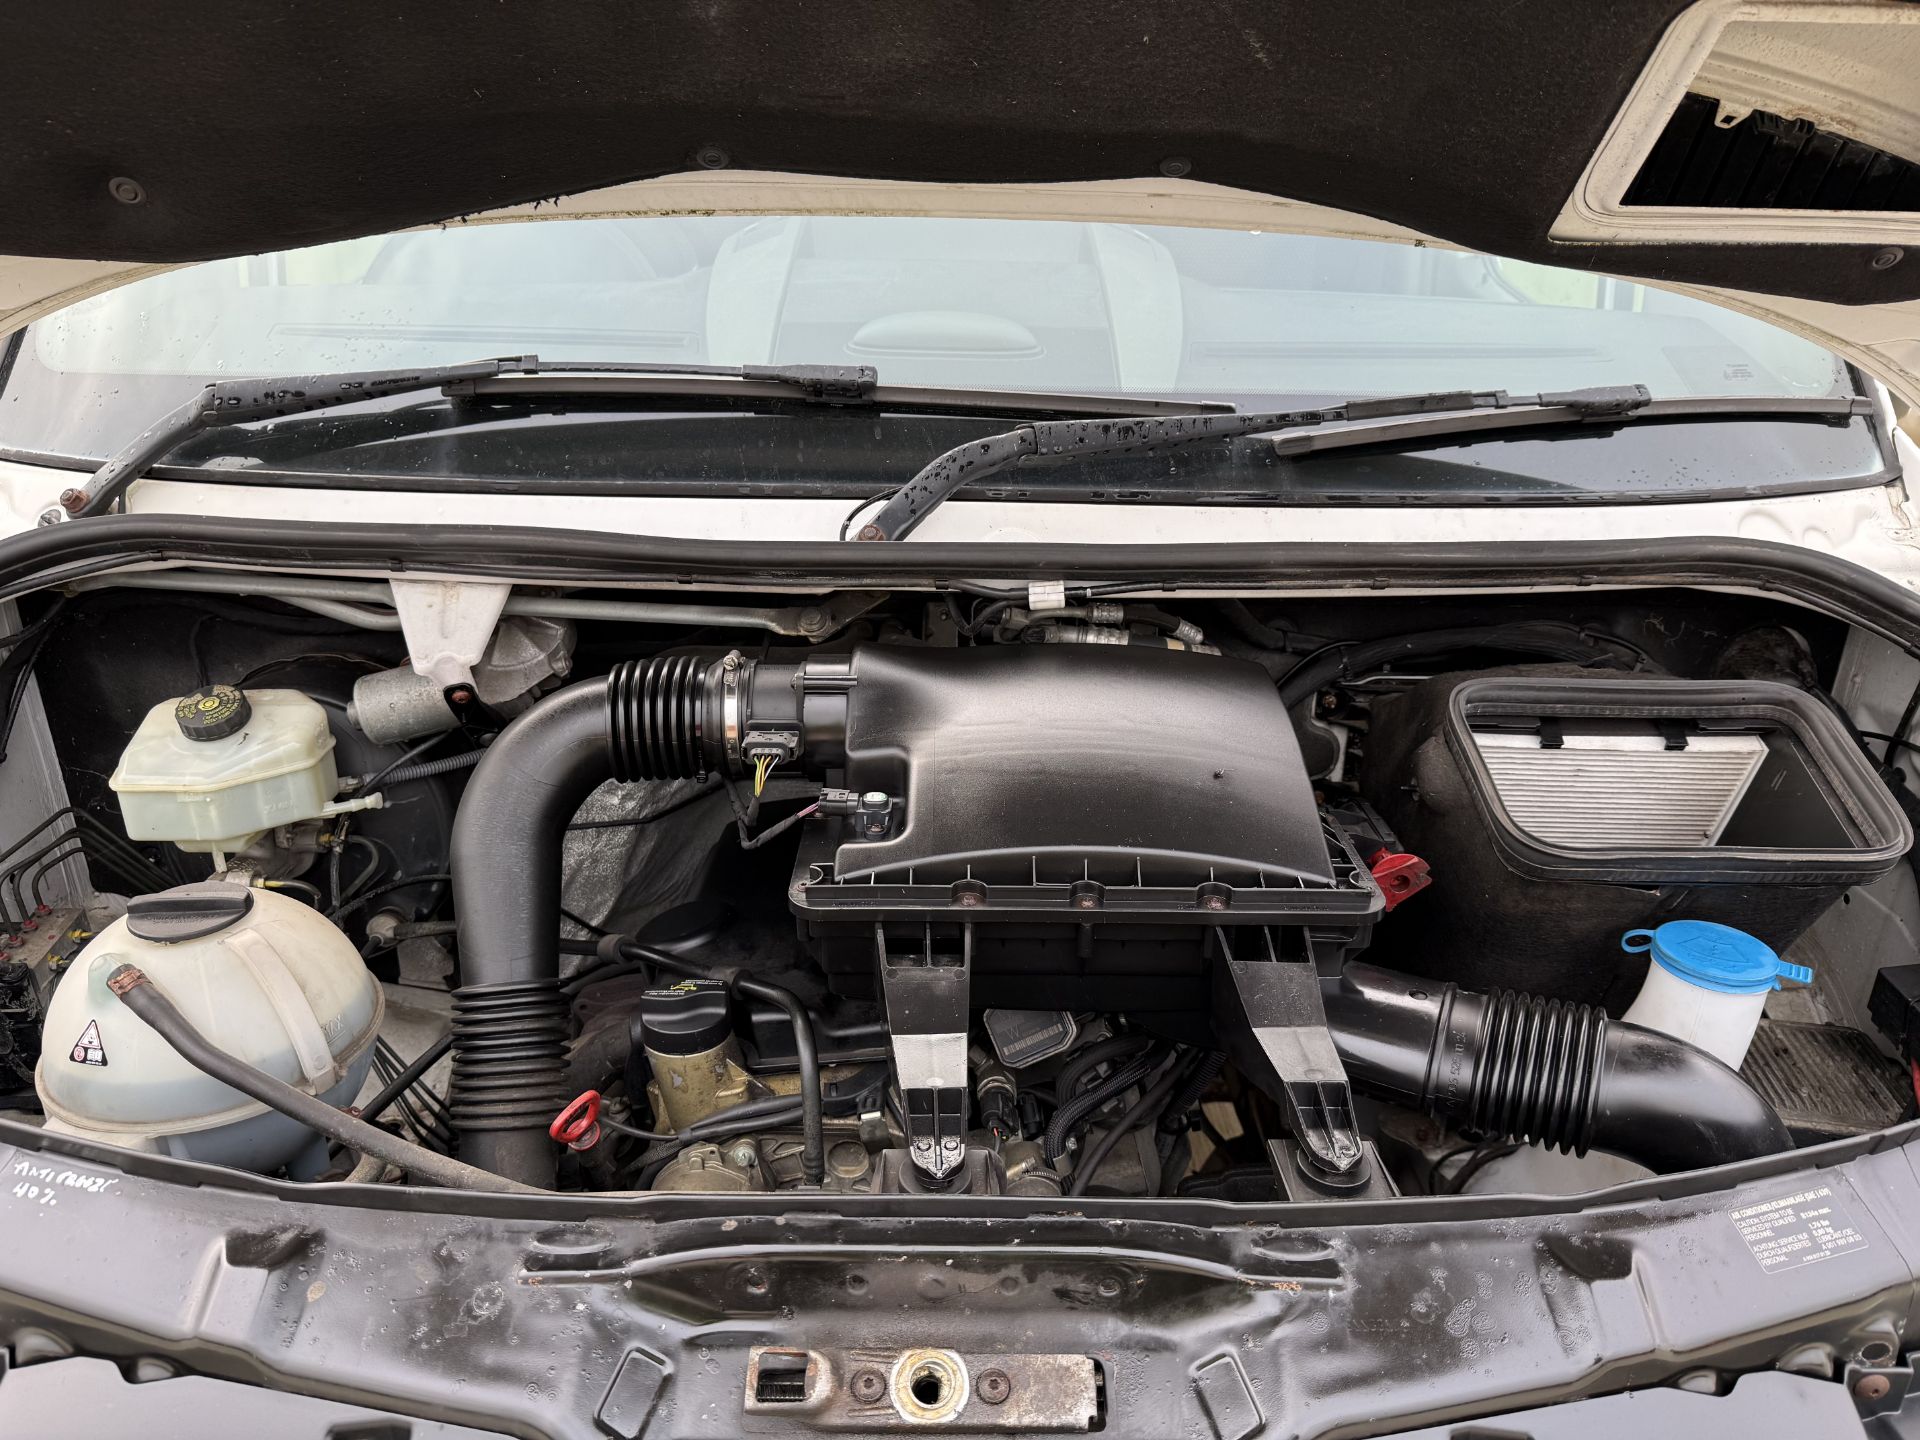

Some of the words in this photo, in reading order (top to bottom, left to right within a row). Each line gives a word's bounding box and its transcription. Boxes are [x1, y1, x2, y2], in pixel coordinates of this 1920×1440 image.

[13, 1161, 55, 1182] ANTI
[1760, 1212, 1780, 1222] SYSTEM
[1772, 1216, 1796, 1227] QUALIFIED
